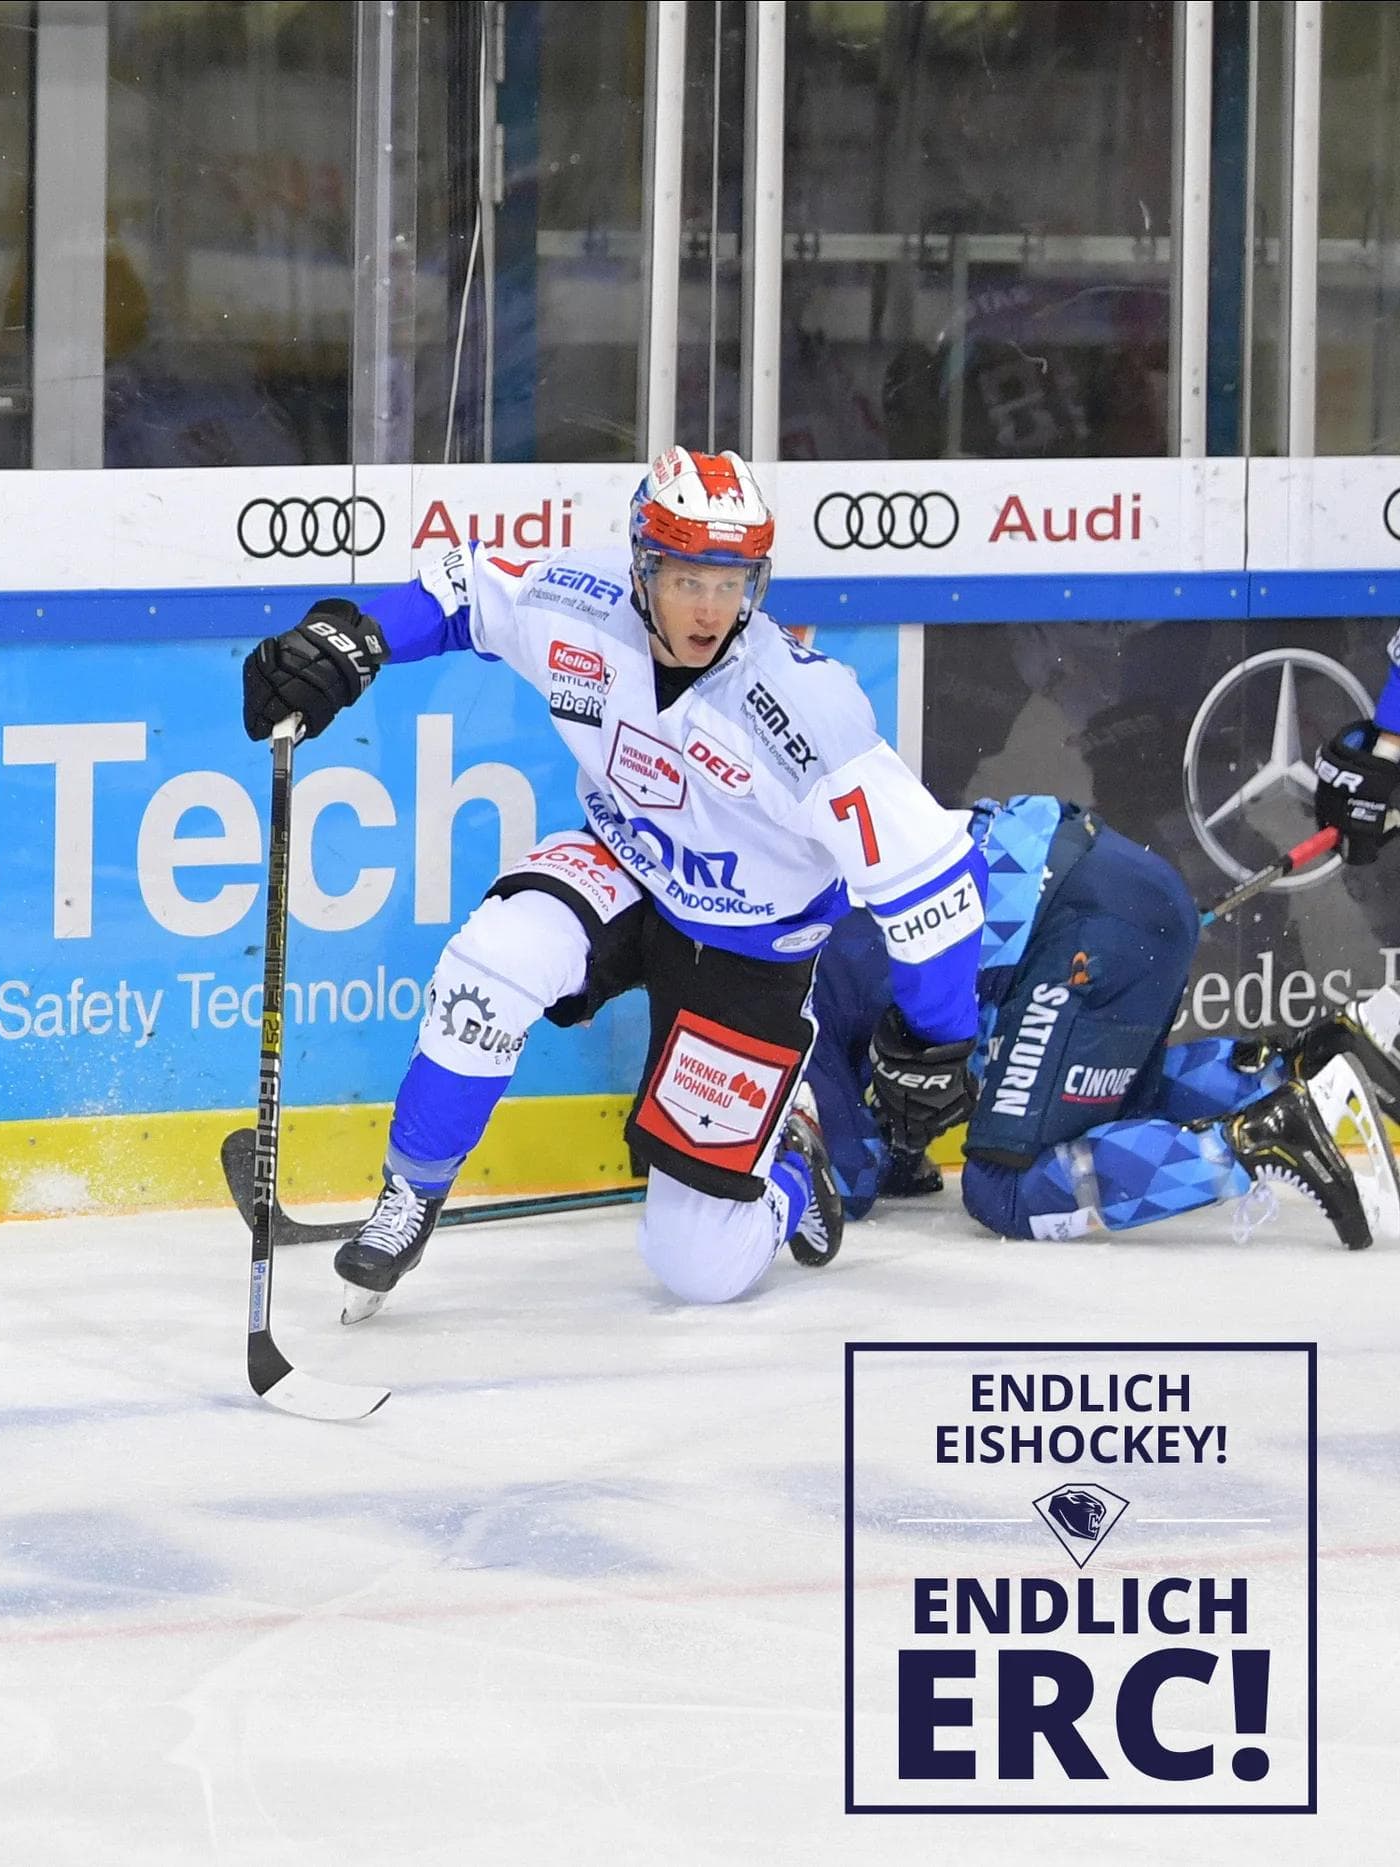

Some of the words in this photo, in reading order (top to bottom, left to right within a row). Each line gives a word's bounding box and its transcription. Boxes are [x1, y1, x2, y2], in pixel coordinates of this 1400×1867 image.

[412, 500, 572, 550] Audi
[989, 493, 1141, 542] Audi
[688, 741, 751, 789] DEL
[830, 786, 880, 867] 7
[585, 791, 614, 834] KARL
[607, 830, 657, 878] STORZ
[665, 879, 776, 916] ENDOSKOPE
[579, 879, 609, 912] group
[888, 888, 971, 943] CHOLZ
[177, 965, 432, 1029] Technolo
[679, 1053, 728, 1088] WERNER
[991, 983, 1070, 1117] SATURN
[673, 1072, 735, 1110] WOHNBAU
[876, 1062, 952, 1090] UER
[1064, 1064, 1138, 1098] CINQUE
